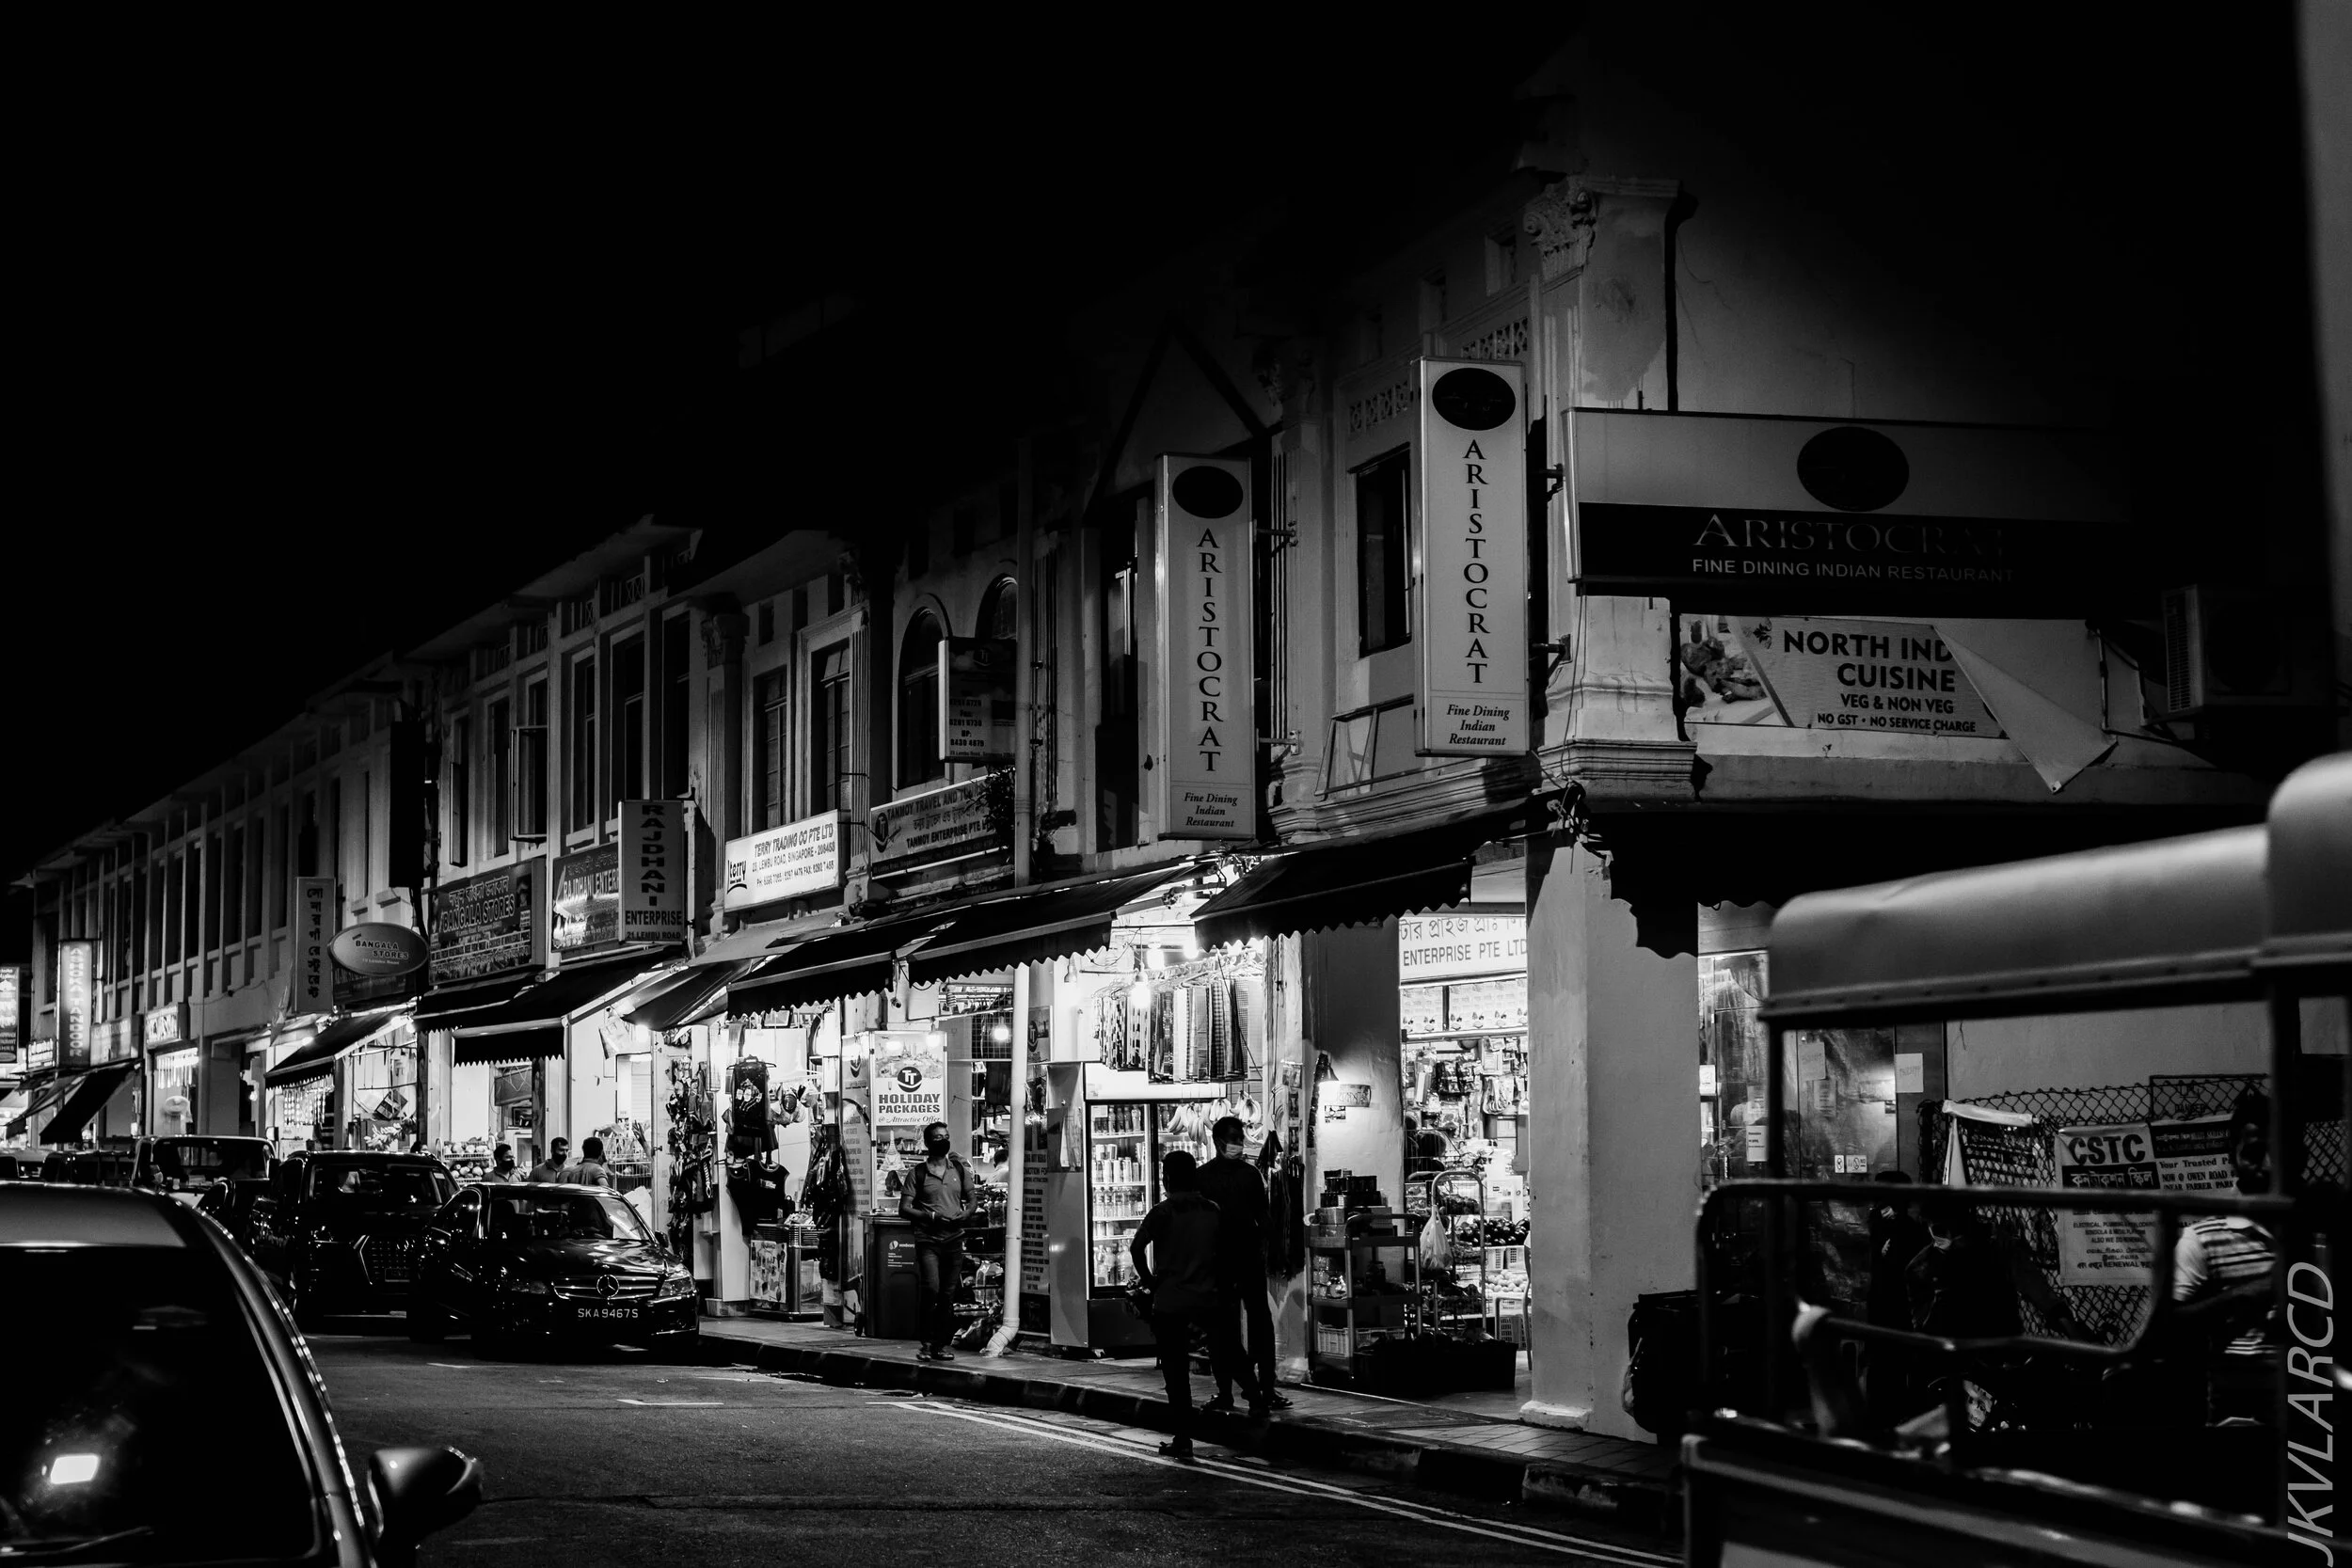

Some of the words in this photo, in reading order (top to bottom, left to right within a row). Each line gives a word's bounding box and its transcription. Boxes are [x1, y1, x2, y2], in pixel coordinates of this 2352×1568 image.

[1463, 438, 1490, 684] ARISTOCRAT
[1692, 558, 1737, 575] FINE
[1742, 560, 1810, 577] DINING
[1816, 562, 1882, 578] INDIAN
[1887, 564, 2014, 583] RESTAURANT
[1196, 528, 1224, 772] ARISTOCRAT
[1784, 630, 1890, 659] NORTH
[1836, 663, 1957, 692] CUISINE
[1840, 692, 1869, 709] VEG
[1873, 695, 1884, 710] &
[1888, 696, 1922, 712] NON
[1925, 698, 1954, 715] VEG
[1446, 704, 1470, 719] Fine
[1472, 705, 1511, 721] Dining
[1459, 719, 1496, 734] Indian
[1817, 713, 1836, 725] NO
[1836, 714, 1858, 727] GST
[1869, 716, 1887, 728] NO
[1889, 717, 1933, 731] SERVICE
[1934, 719, 1977, 733] CHARGE
[1448, 733, 1506, 747] Restaurant
[916, 795, 942, 814] TRAVEL
[1184, 792, 1204, 804] Fine
[1205, 794, 1238, 808] Dining
[1195, 805, 1226, 816] Indian
[1185, 816, 1235, 829] Restaurant
[755, 839, 772, 858] TERRY
[773, 832, 798, 853] TRADING
[799, 830, 808, 846] CO
[809, 826, 820, 844] PTE
[821, 823, 834, 840] LTD
[931, 823, 968, 845] ENTERPRISE
[641, 804, 666, 907] RAJDHANI
[787, 847, 815, 863] SINGAPORE
[442, 902, 482, 933] BANGALA
[483, 894, 516, 924] STORES
[625, 910, 683, 927] ENTERPRISE
[356, 940, 399, 950] BANGALA
[1403, 944, 1471, 967] ENTERPRISE
[1479, 941, 1500, 958] PTE
[1507, 939, 1527, 957] LTD
[373, 950, 409, 959] STORES
[879, 1094, 941, 1104] HOLIDAY
[879, 1104, 941, 1114] PACKAGES
[922, 1116, 941, 1124] Offer
[2069, 1133, 2146, 1164] CSTC
[2159, 1160, 2178, 1168] Your
[2182, 1157, 2217, 1167] Trusted
[2186, 1171, 2206, 1180] OWEN
[2208, 1170, 2228, 1180] ROAD
[2215, 1180, 2234, 1189] PARK
[577, 1307, 639, 1319] SKA9467S
